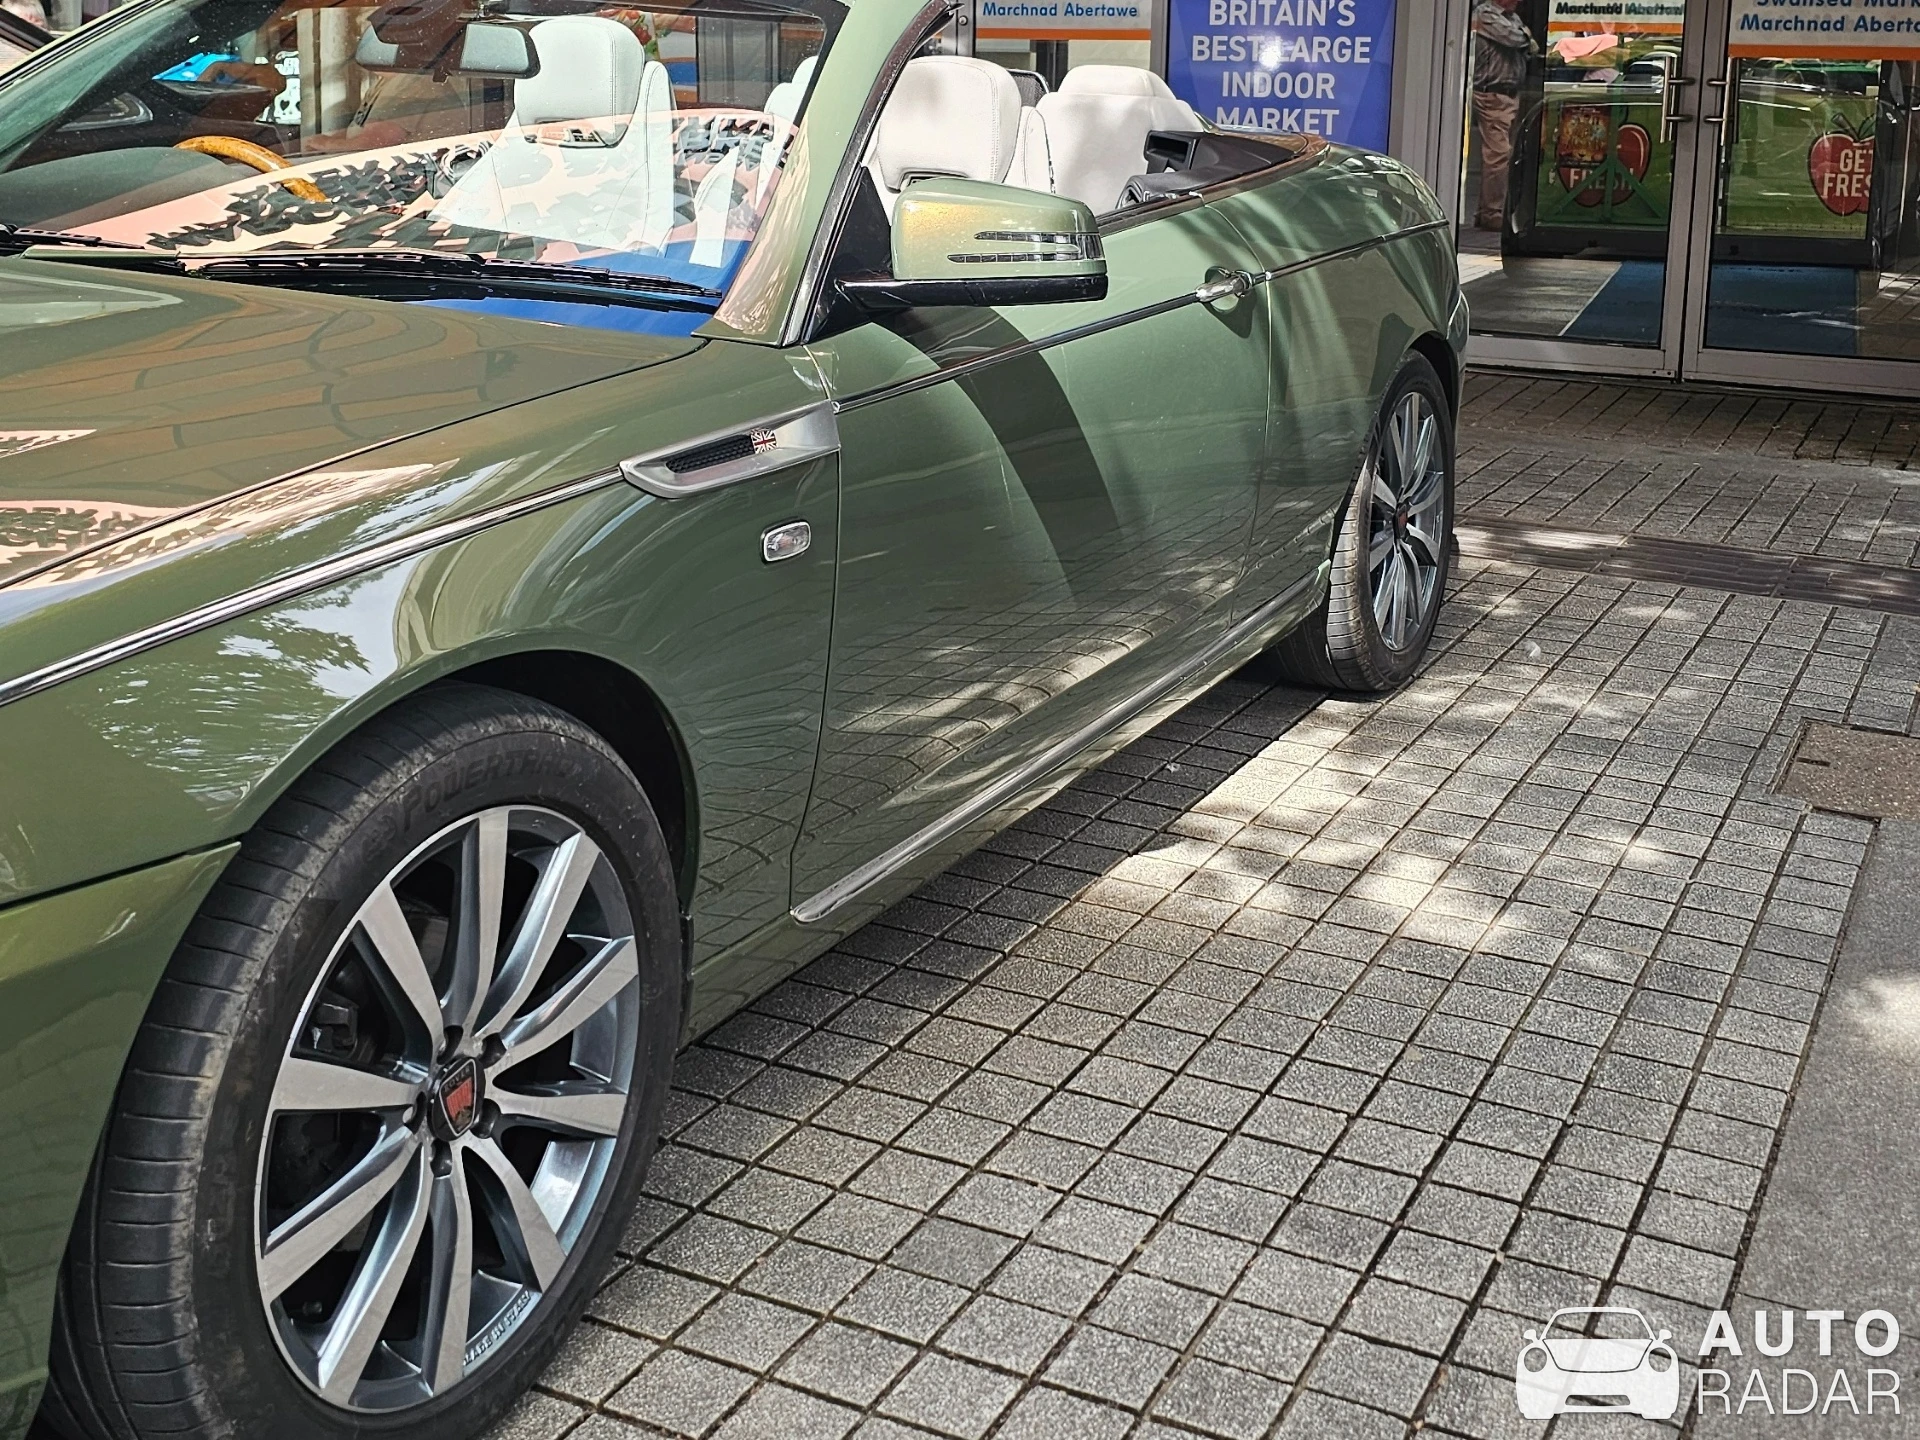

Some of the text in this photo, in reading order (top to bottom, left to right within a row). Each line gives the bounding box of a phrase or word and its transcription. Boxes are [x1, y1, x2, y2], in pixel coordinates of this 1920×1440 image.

[982, 2, 1139, 17] Marchnad Abertawe
[1209, 0, 1356, 27] BRITAIN'S
[1740, 13, 1846, 32] Marchnad
[1192, 35, 1372, 64] BEST LARGE
[1222, 71, 1336, 100] INDOOR
[1216, 106, 1340, 135] MARKET
